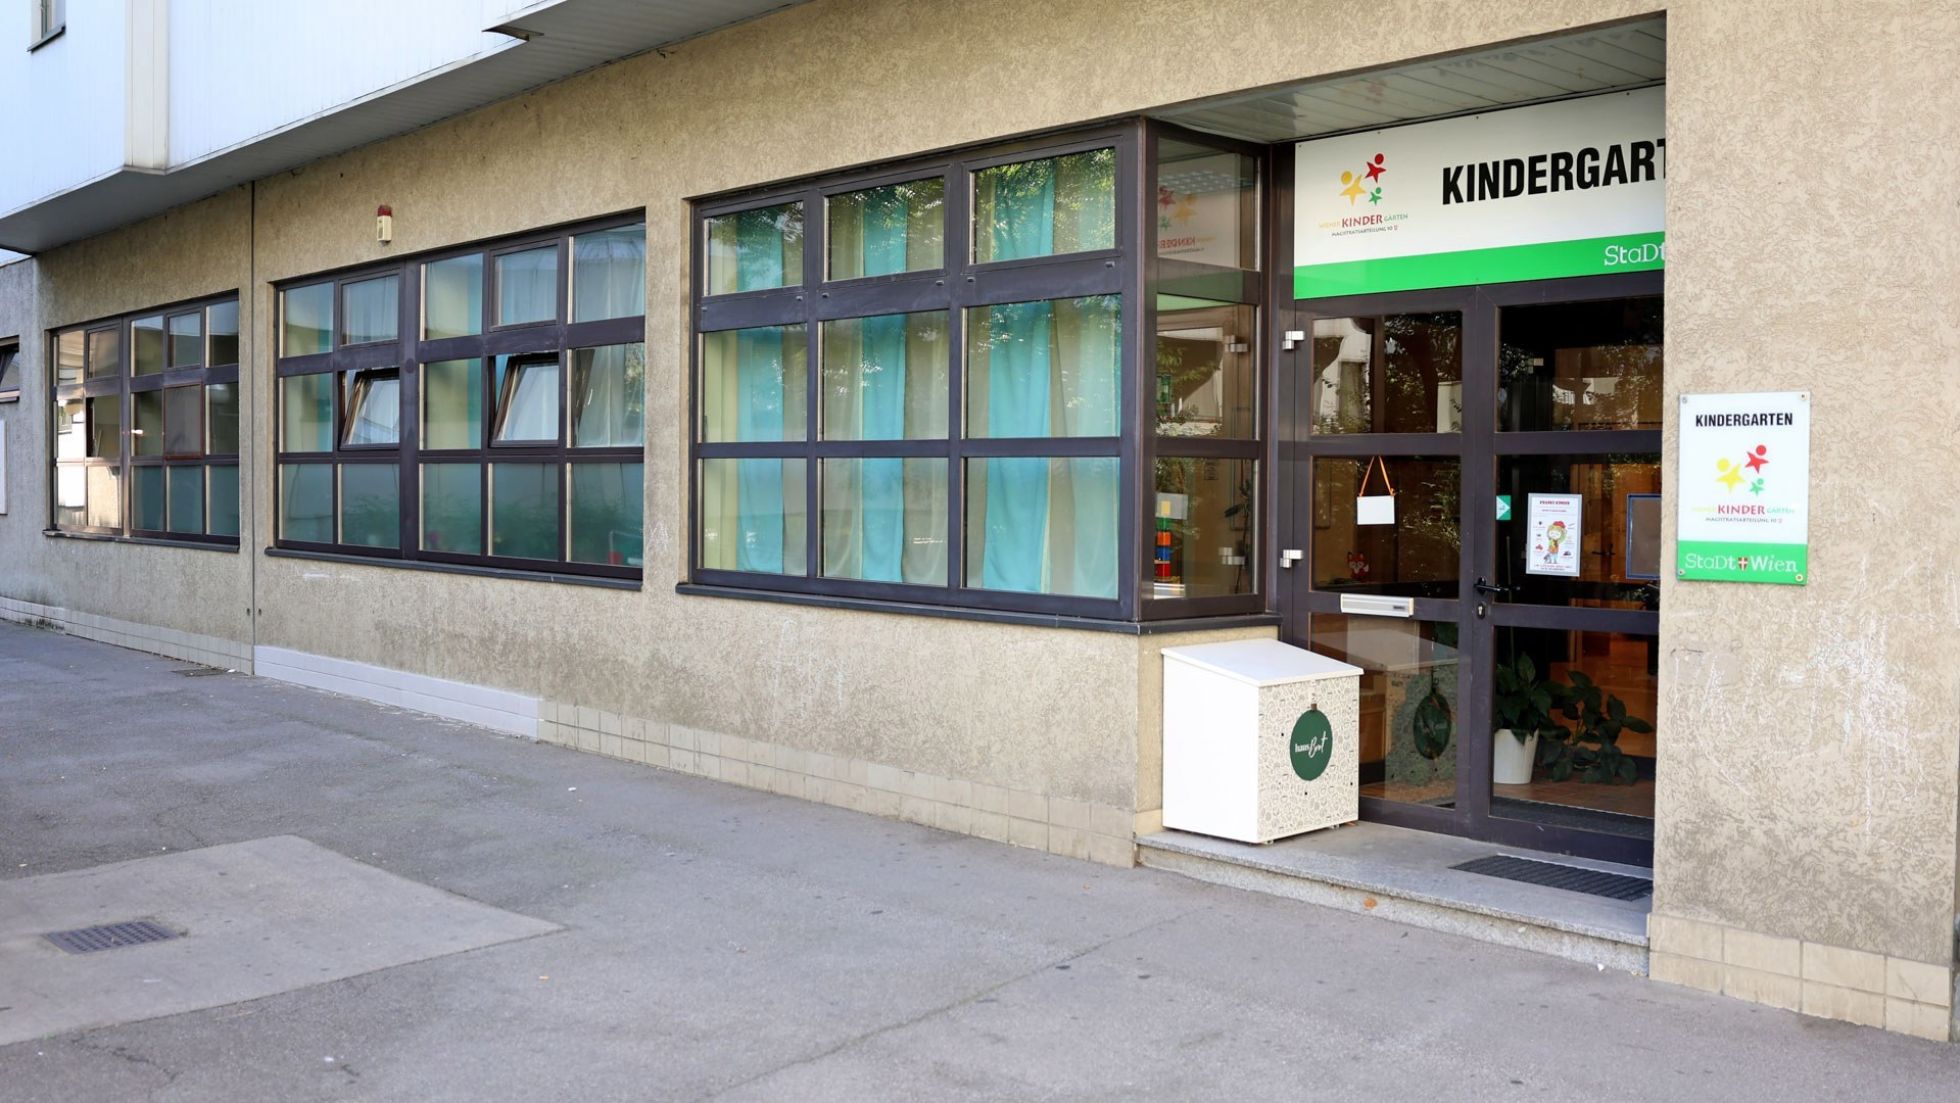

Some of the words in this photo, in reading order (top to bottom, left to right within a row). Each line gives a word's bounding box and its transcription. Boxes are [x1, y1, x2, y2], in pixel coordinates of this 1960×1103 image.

[1341, 214, 1383, 228] KINDER
[1695, 412, 1793, 427] KINDERGARTEN
[1717, 504, 1766, 515] KINDER
[1750, 554, 1798, 573] Wien
